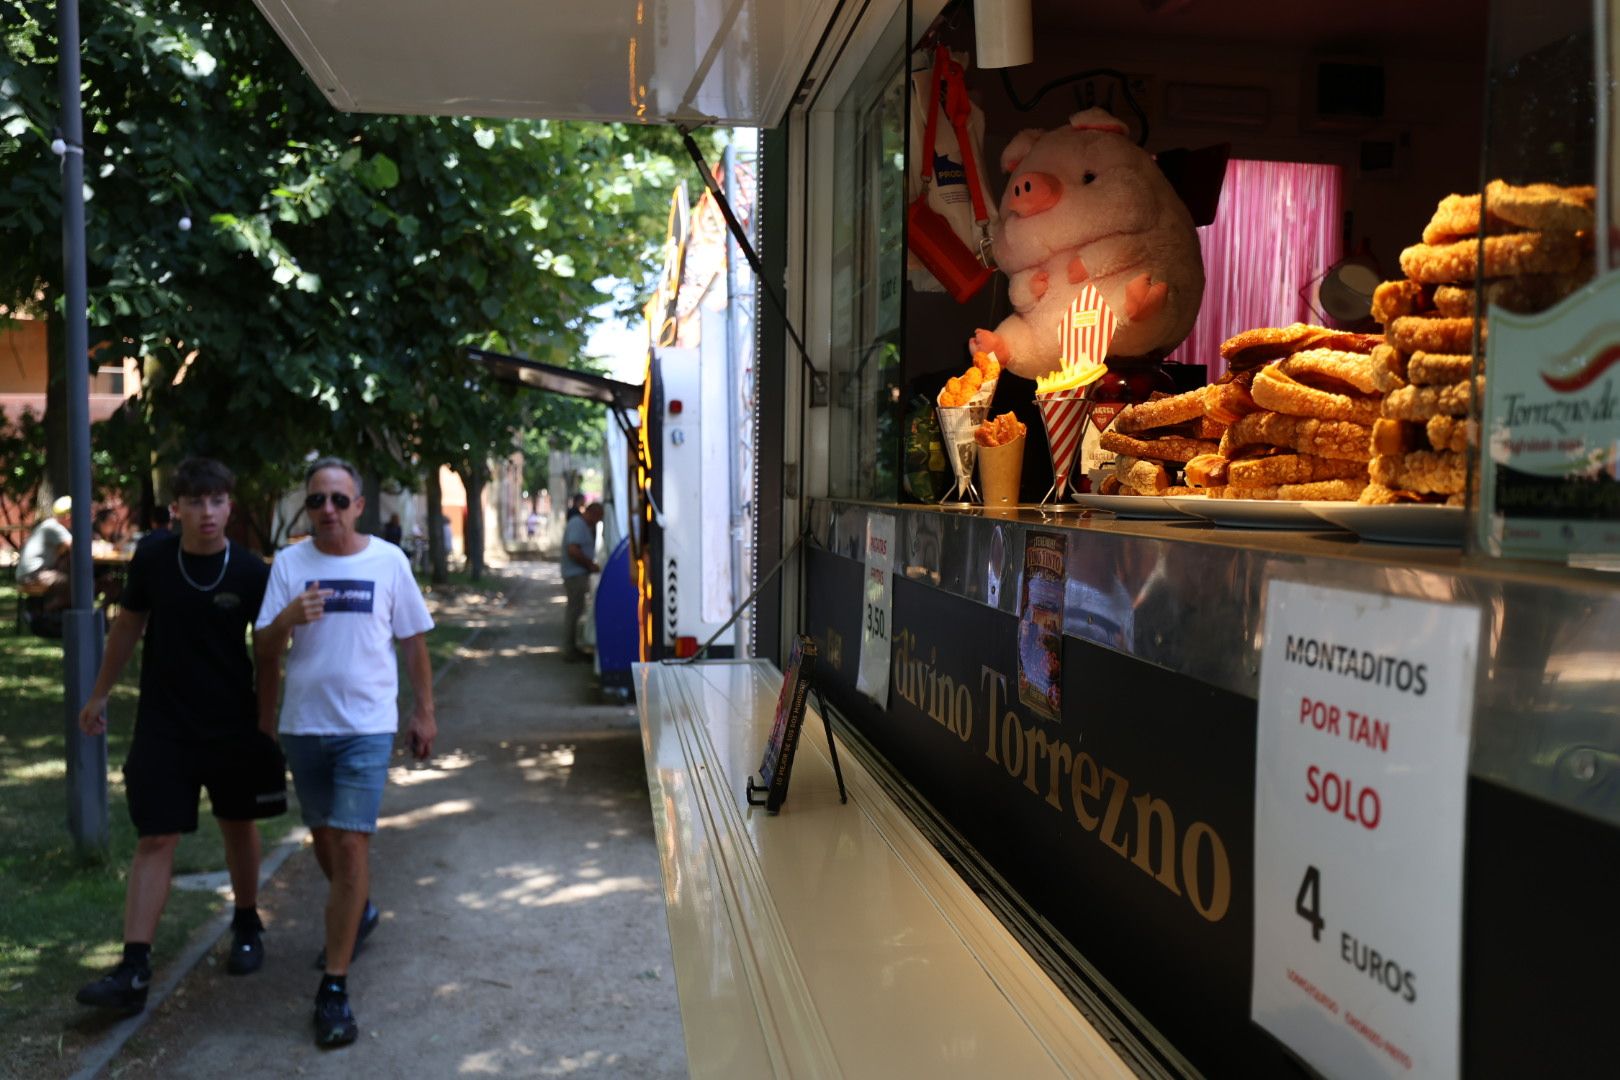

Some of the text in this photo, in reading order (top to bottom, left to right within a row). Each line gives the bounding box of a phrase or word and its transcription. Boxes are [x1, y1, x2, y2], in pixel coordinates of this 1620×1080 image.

[867, 602, 885, 640] 3,50
[1285, 634, 1428, 696] MONTADITOS
[1299, 697, 1390, 752] POR TAN
[893, 627, 1231, 922] divino Torrezno
[1305, 764, 1382, 830] SOLO
[1295, 865, 1325, 943] 4
[1341, 931, 1417, 1003] EUROS
